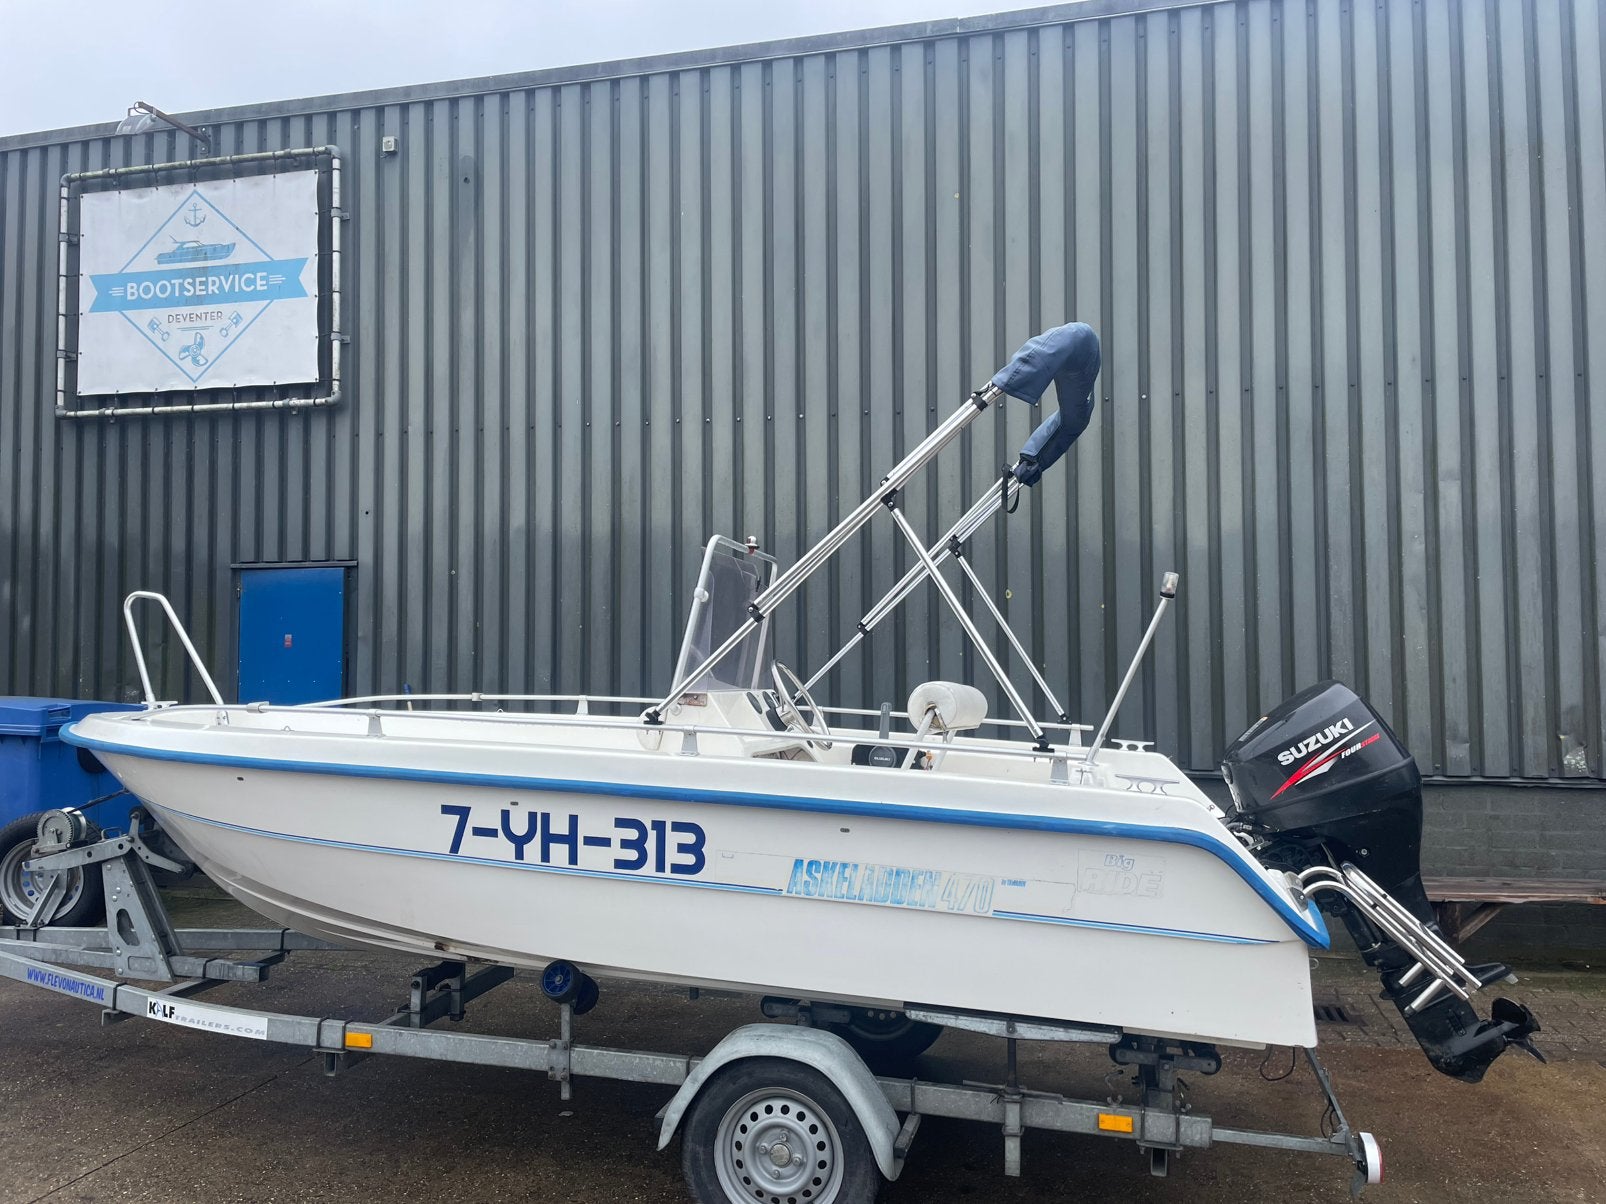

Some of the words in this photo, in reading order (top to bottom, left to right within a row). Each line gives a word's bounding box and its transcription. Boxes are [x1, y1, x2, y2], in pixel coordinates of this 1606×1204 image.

[126, 272, 268, 300] BOOTSERVICE
[167, 310, 223, 324] DEVENTER
[1277, 717, 1354, 766] SUZUKI
[440, 804, 707, 876] 7-YH-313
[1104, 854, 1135, 871] Big
[786, 858, 942, 909] ASKELADDEN
[940, 872, 996, 914] 470
[26, 967, 105, 1001] WWW.FLEVONAUTICA.NL
